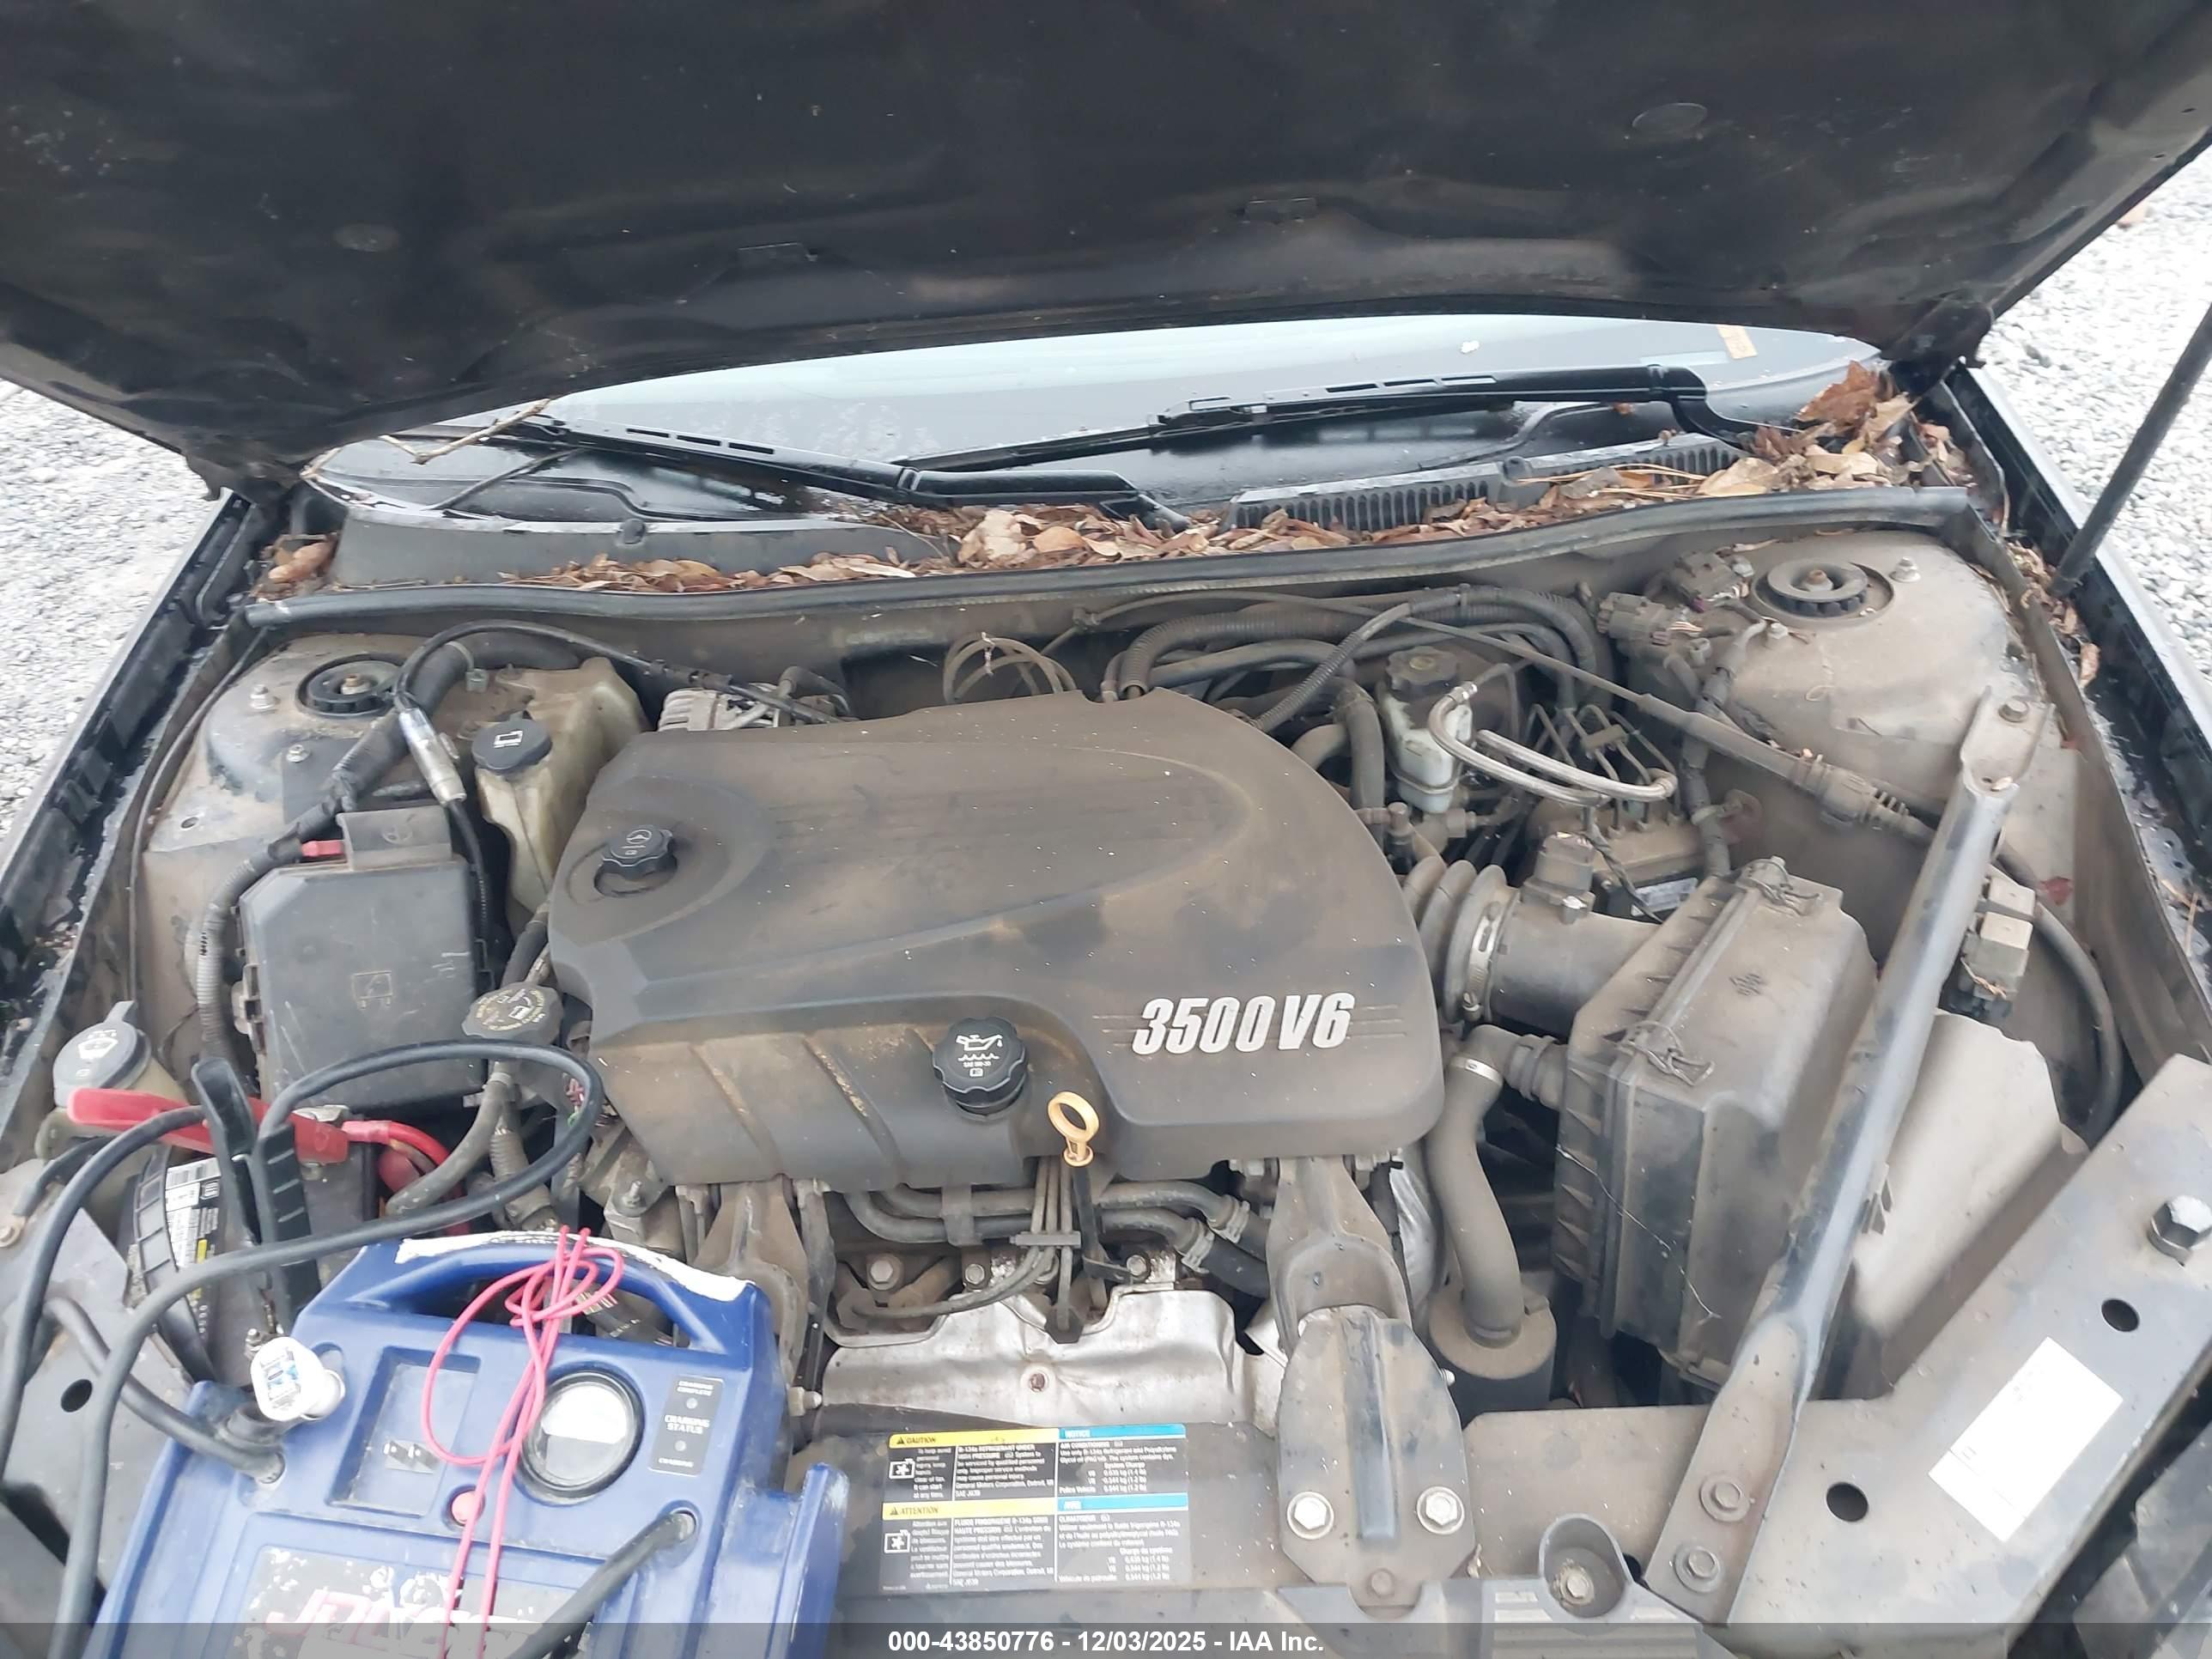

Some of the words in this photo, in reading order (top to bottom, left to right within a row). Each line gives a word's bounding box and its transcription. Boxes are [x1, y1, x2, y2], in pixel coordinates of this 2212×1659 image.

[1132, 996, 1276, 1054] 3500
[1278, 993, 1356, 1050] V6
[666, 1423, 702, 1434] STATUS
